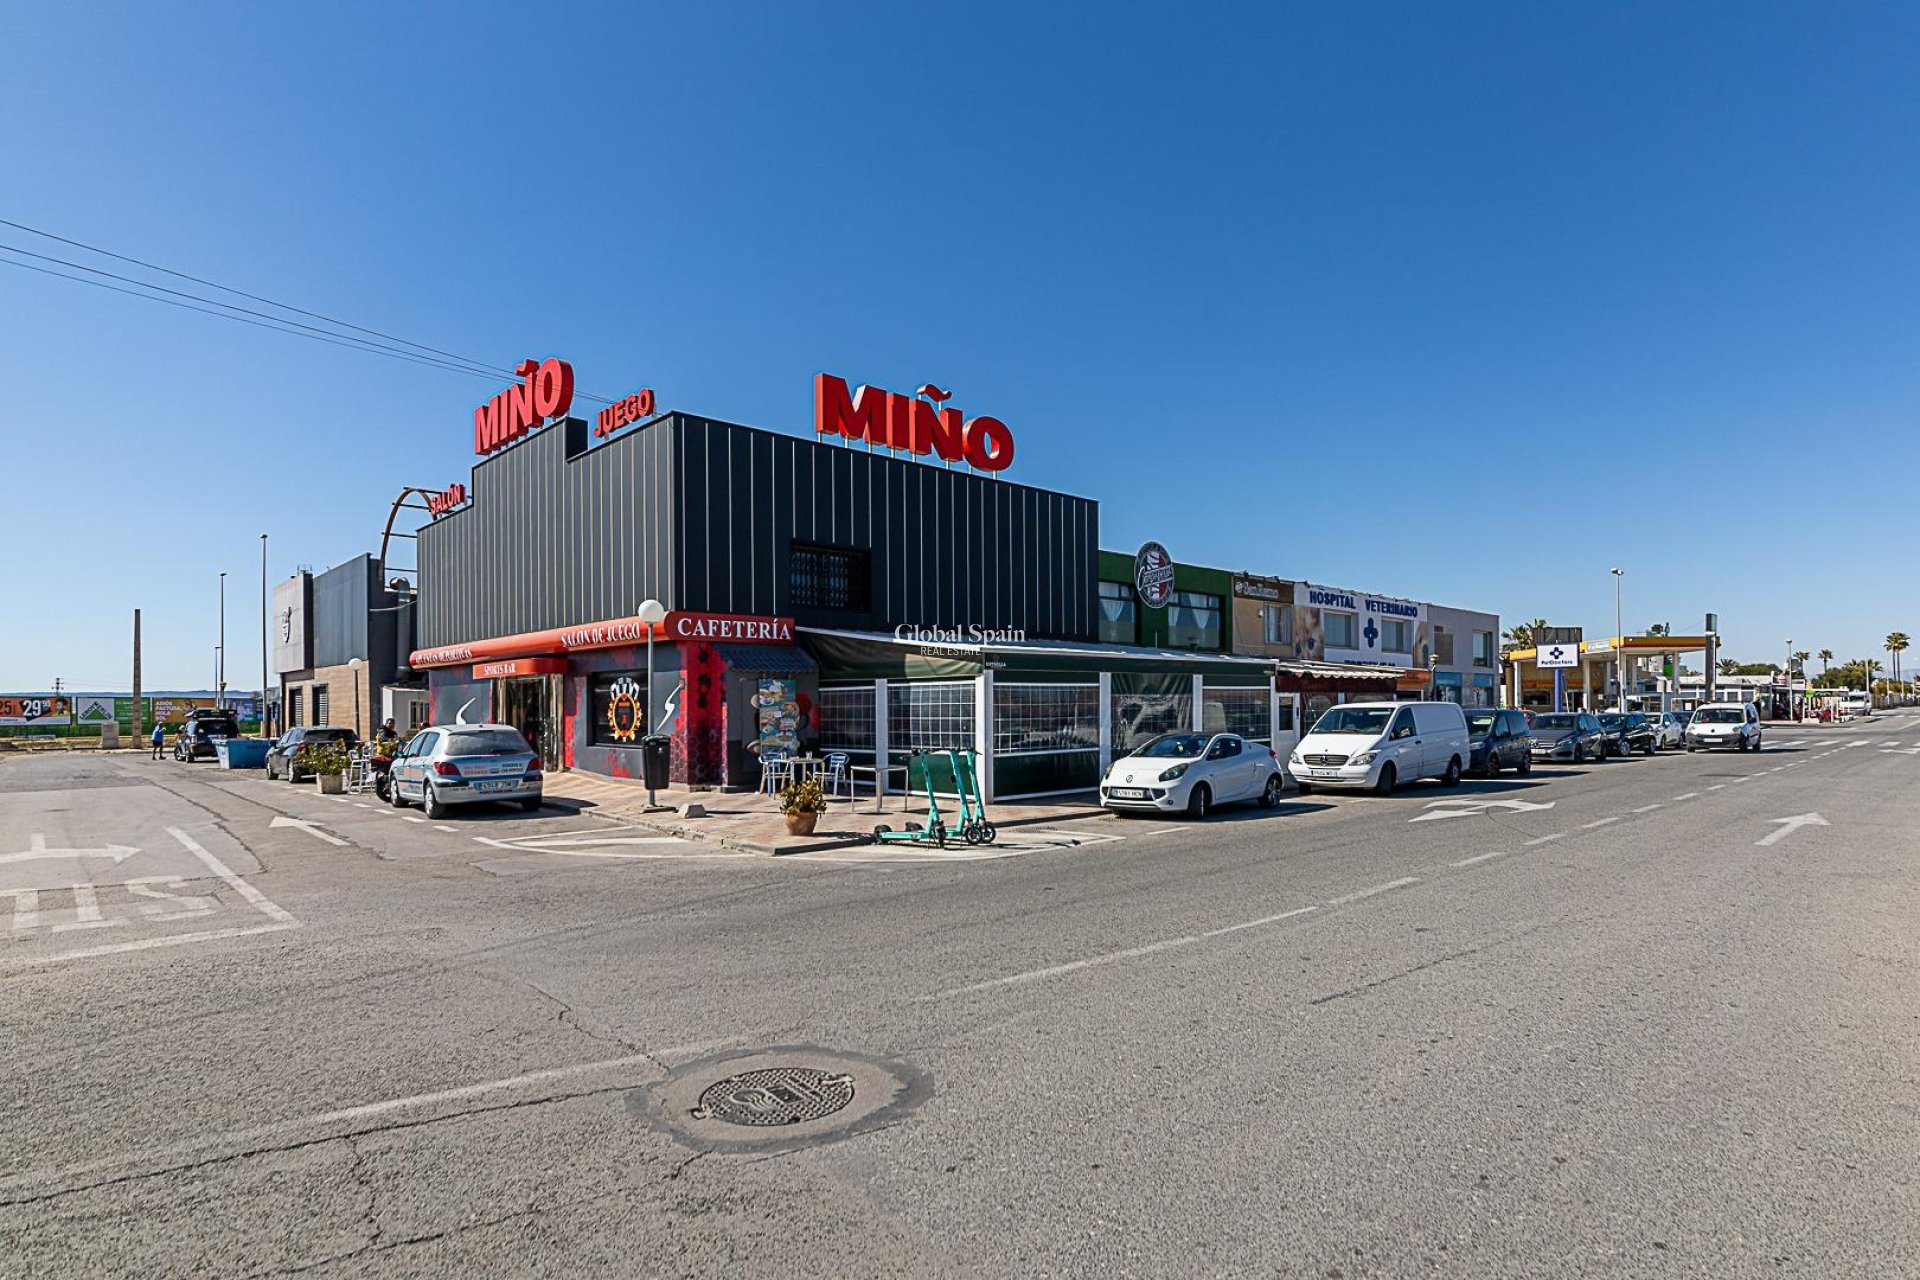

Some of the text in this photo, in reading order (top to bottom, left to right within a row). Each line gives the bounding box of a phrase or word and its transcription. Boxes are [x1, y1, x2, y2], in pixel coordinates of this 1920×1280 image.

[474, 357, 574, 455] MIÑO
[594, 388, 655, 437] JUEGO
[815, 373, 1015, 472] MIÑO
[430, 484, 465, 515] SALÓN
[1309, 590, 1418, 618] HOSPITAL VETERINARIO
[592, 628, 604, 643] DE
[606, 622, 640, 641] JUEGO
[677, 617, 792, 641] CAFETERÍA
[22, 699, 42, 717] 29
